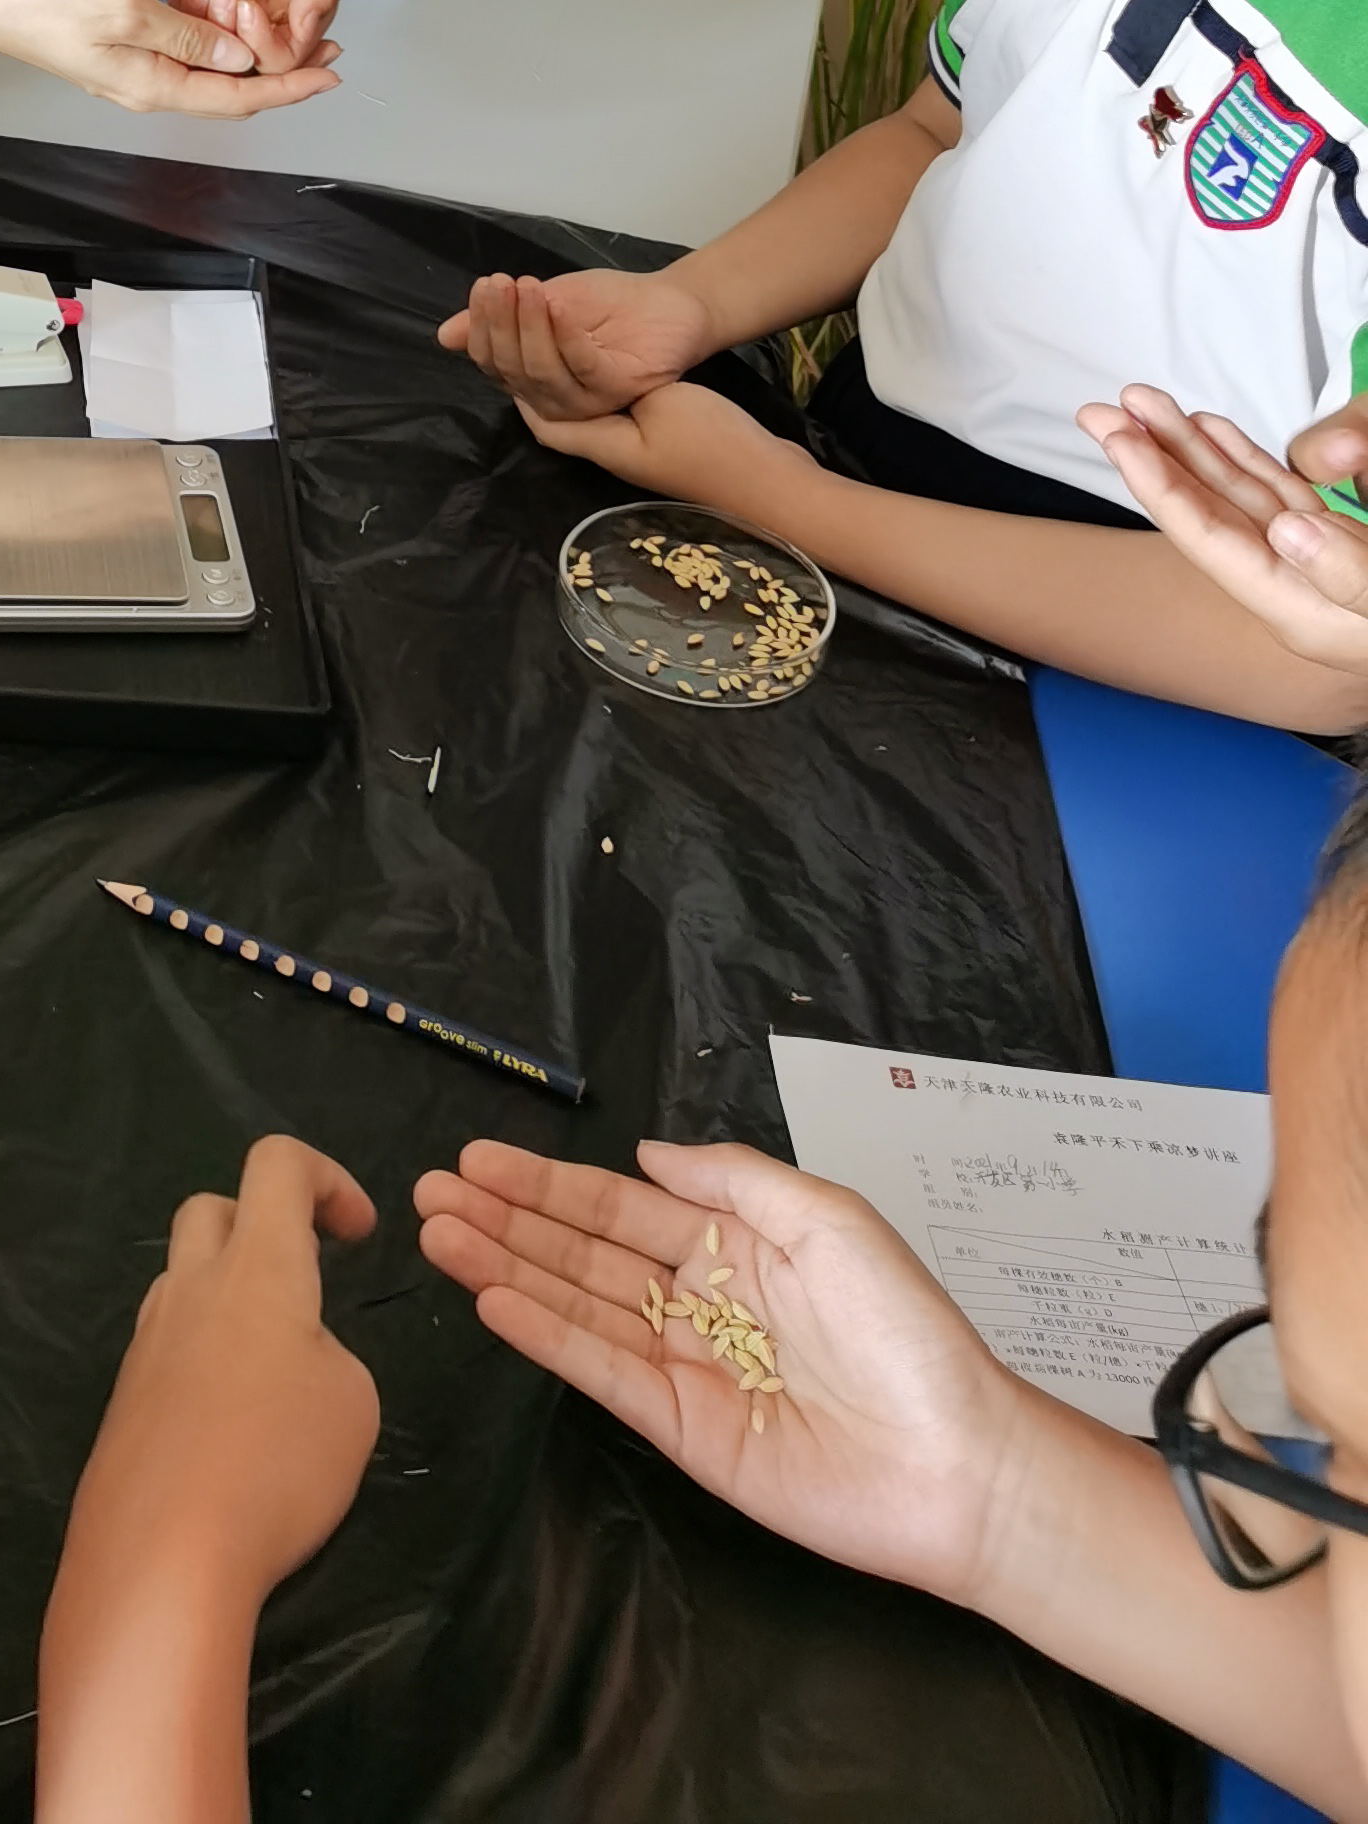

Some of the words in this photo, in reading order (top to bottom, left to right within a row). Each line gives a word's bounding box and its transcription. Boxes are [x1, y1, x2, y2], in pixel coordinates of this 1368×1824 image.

[465, 1039, 488, 1056] slim
[501, 1053, 549, 1084] LYRA
[923, 1073, 1144, 1113] 天津天隆农业科技有限公司
[1052, 1130, 1241, 1165] 袁隆平禾下乘凉梦讲座
